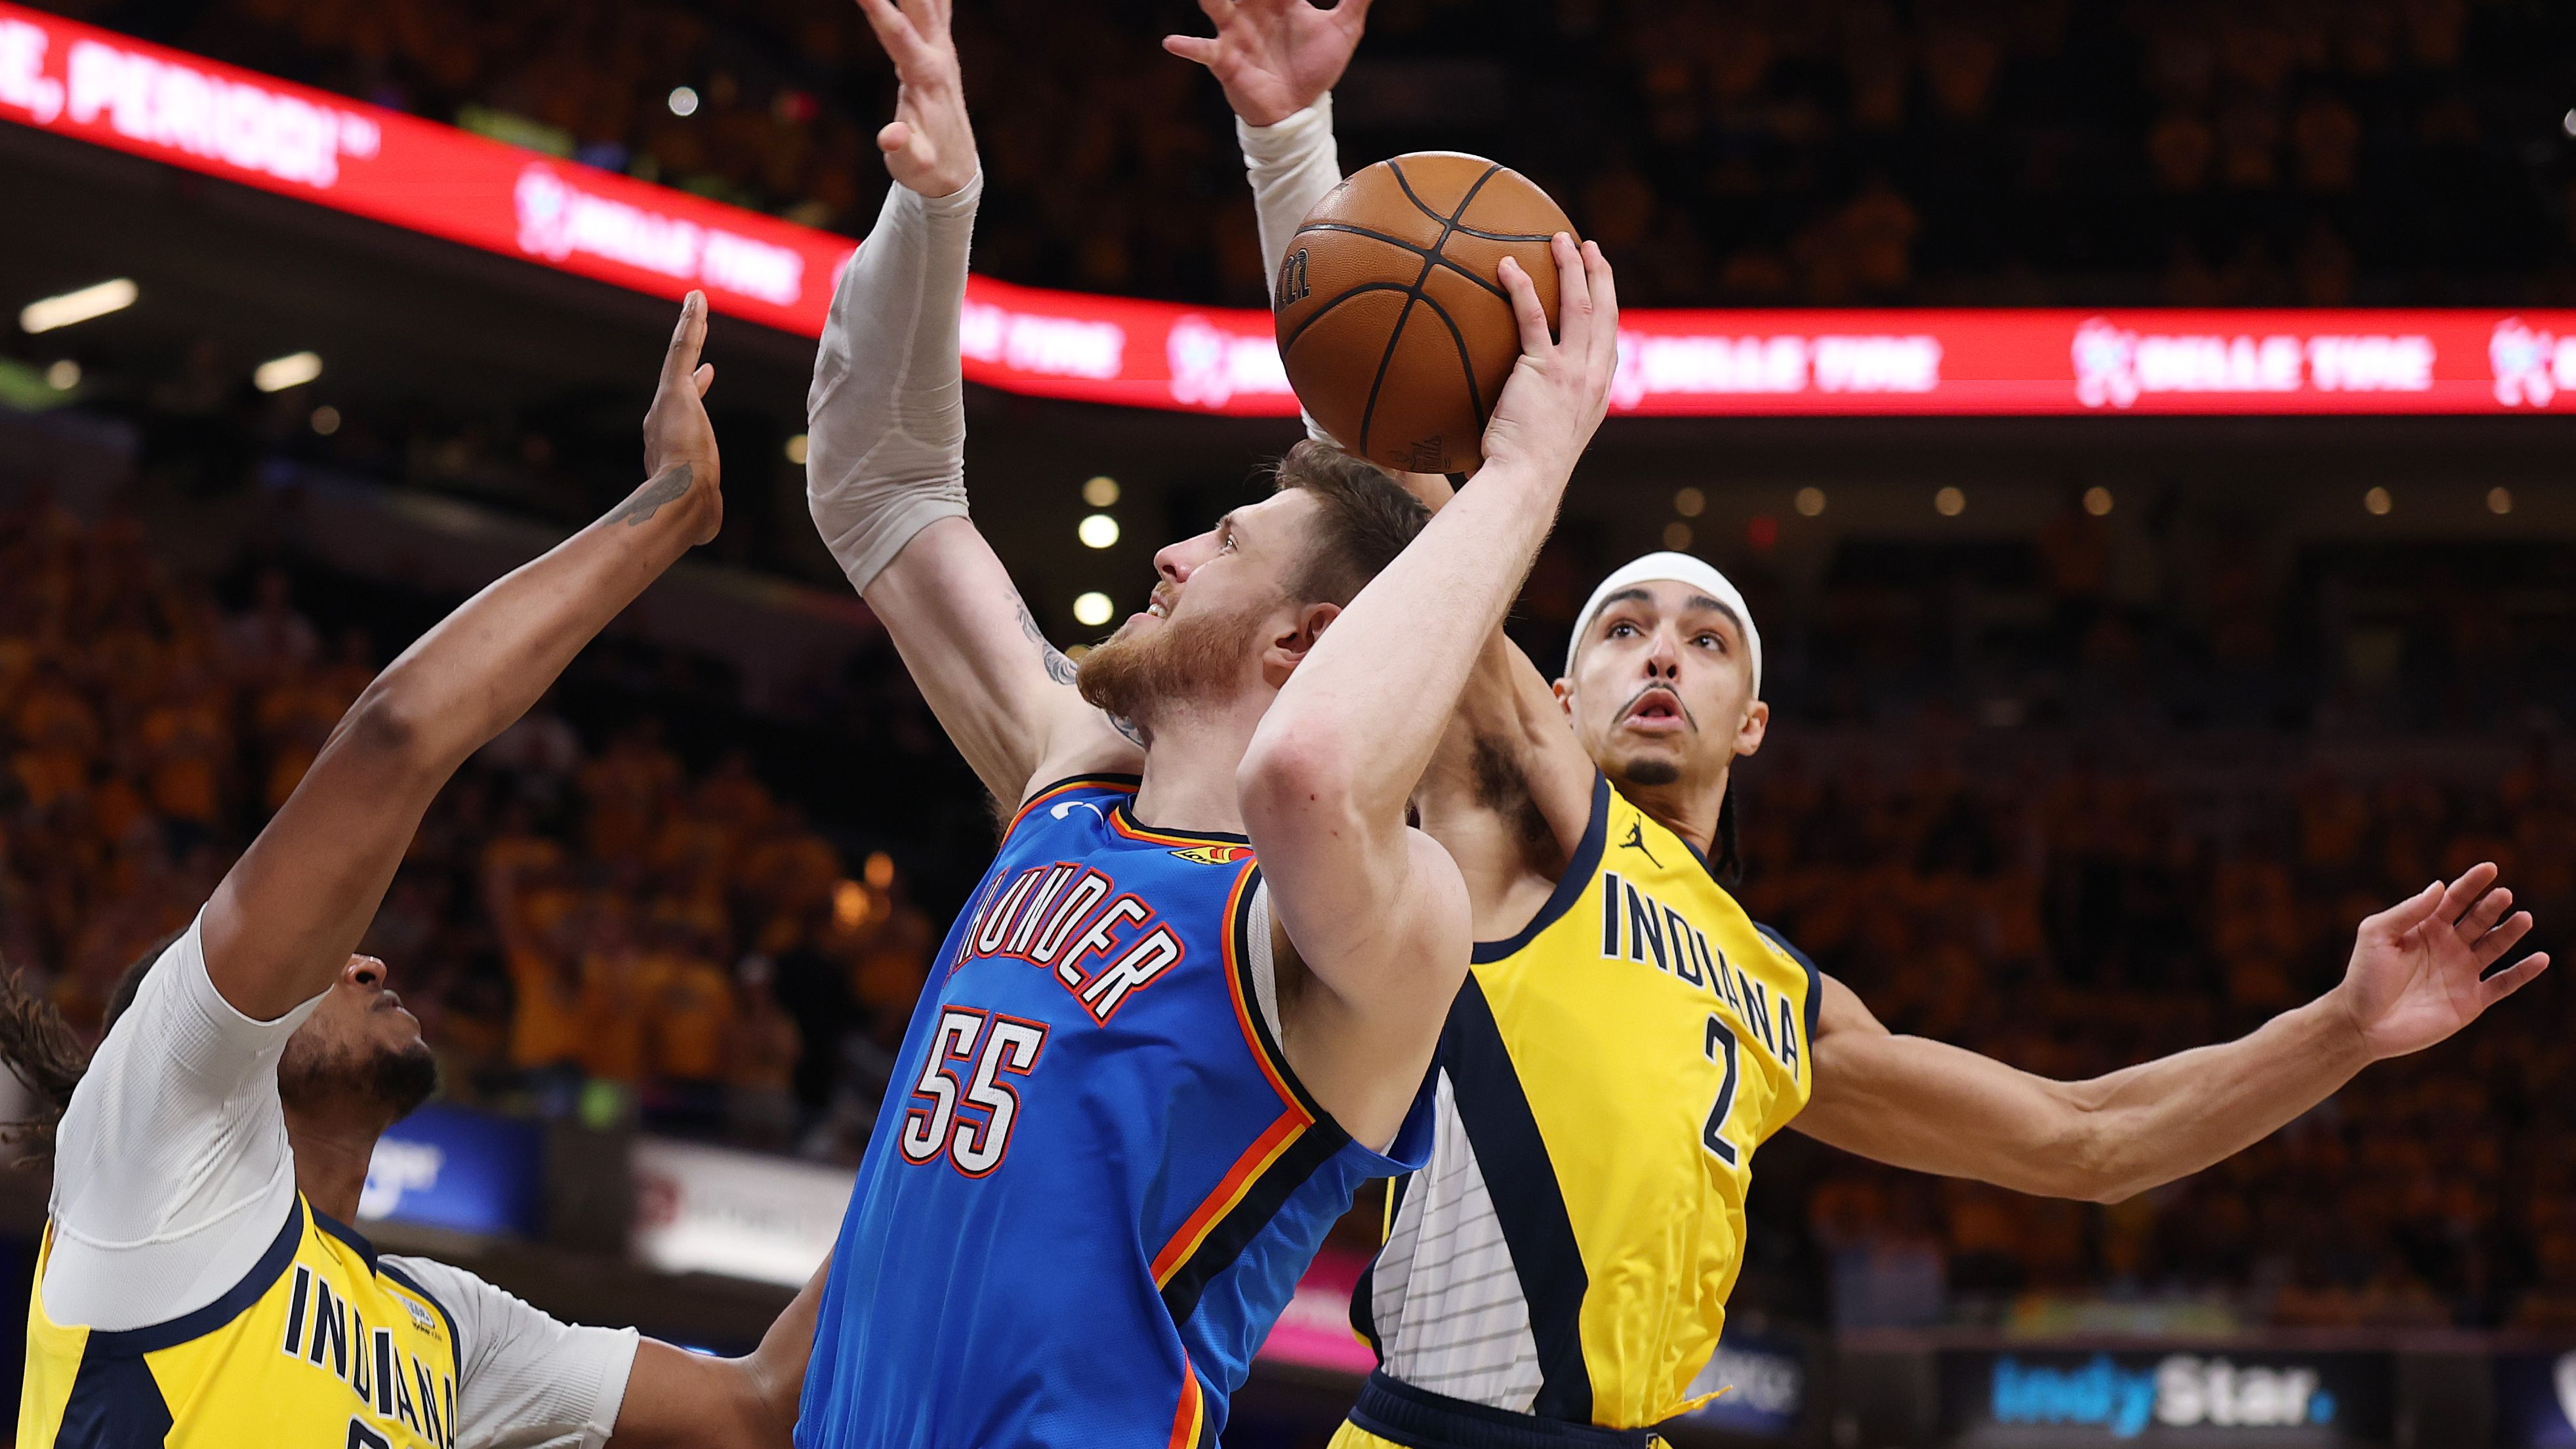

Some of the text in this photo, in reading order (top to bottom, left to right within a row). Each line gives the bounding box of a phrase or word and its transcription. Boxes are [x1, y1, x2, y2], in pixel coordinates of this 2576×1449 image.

[943, 861, 1185, 1029] HUNDER
[1600, 868, 1801, 1088] INDIANA
[899, 1004, 1050, 1180] 55
[1700, 1011, 1740, 1170] 2
[281, 1261, 457, 1449] INDIANA
